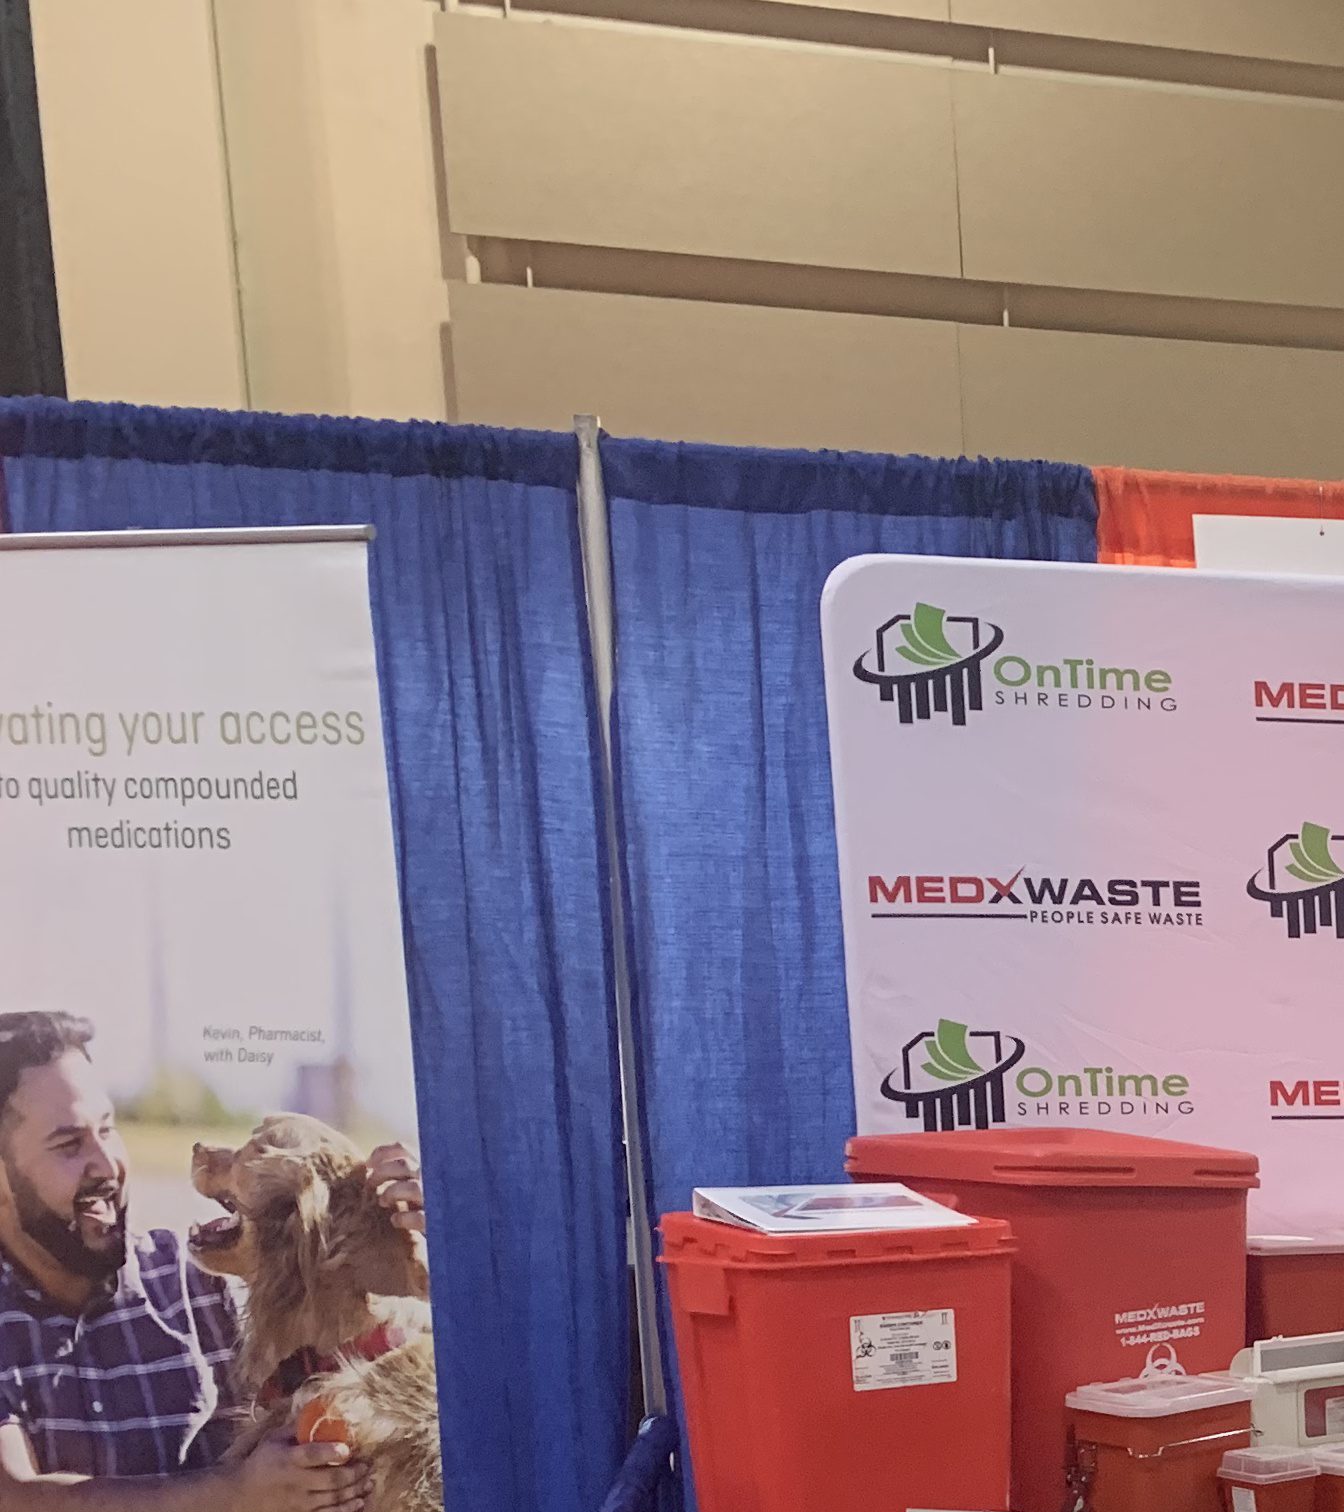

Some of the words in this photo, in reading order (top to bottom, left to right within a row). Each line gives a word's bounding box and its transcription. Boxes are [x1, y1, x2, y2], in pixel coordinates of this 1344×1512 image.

[994, 655, 1172, 693] OnTime
[995, 691, 1178, 712] SHREDDING
[0, 701, 107, 757] ating
[119, 706, 205, 756] your
[219, 706, 365, 746] access
[28, 770, 117, 806] quality
[124, 770, 298, 806] compounded
[67, 819, 232, 850] medications
[869, 867, 1202, 908] MEDXWASTE
[1030, 910, 1094, 925] PEOPLE
[1100, 911, 1143, 925] SAFE
[1148, 911, 1203, 926] WASTE
[248, 1025, 326, 1044] Pharmacist,
[203, 1047, 233, 1063] with
[237, 1047, 275, 1067] Daisy
[1015, 1066, 1190, 1099] OnTime
[1018, 1099, 1195, 1116] SHREDDING
[1115, 1302, 1205, 1324] MEDXWASTE
